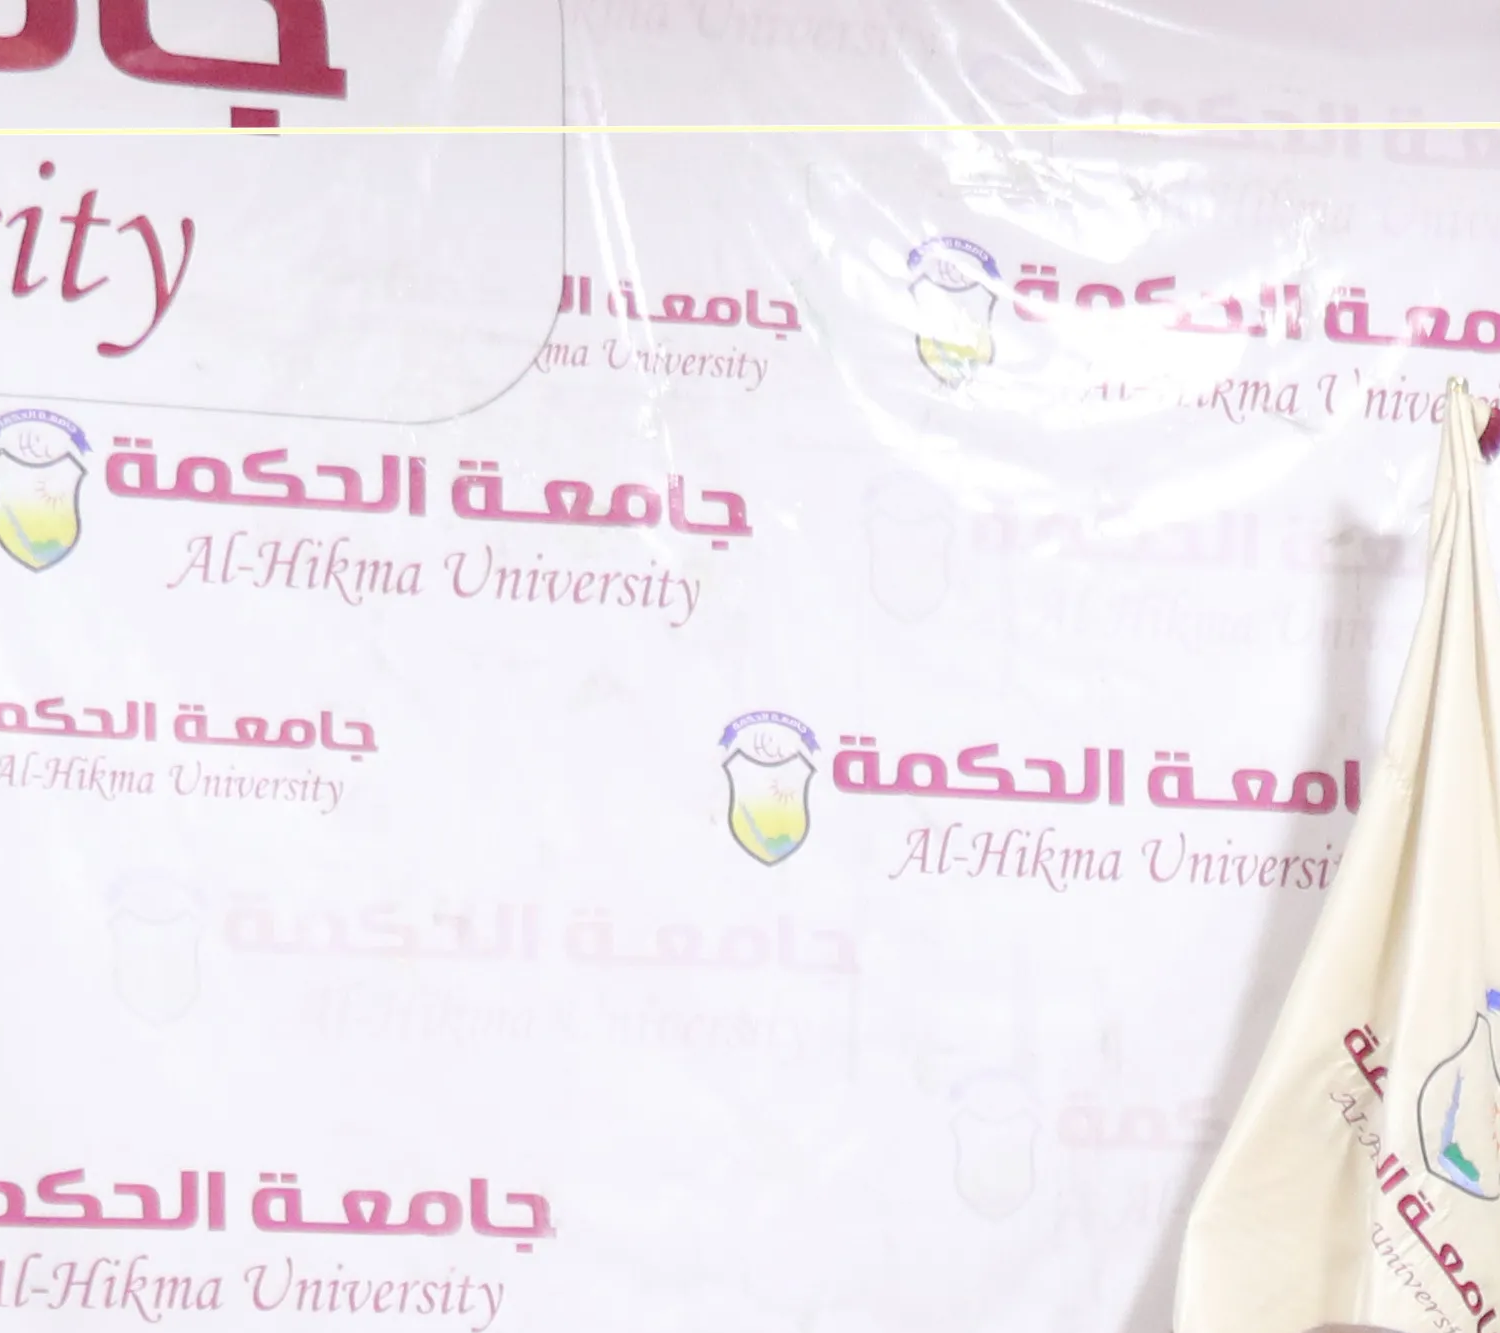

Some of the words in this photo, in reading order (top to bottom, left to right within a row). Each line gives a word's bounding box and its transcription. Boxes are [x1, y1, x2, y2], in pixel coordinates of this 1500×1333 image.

[105, 436, 426, 517] الحكمة
[451, 460, 753, 550] جامعة
[167, 530, 422, 606] Al-Hikma
[443, 544, 701, 628] University
[174, 703, 378, 762] جامعة
[832, 734, 1125, 805] الحكمة
[169, 760, 344, 815] University
[1147, 751, 1362, 816] امعة
[888, 822, 1122, 893] Al-Hikma
[1141, 831, 1352, 891] Universi
[251, 1172, 556, 1253] جامعة
[243, 1256, 505, 1333] University
